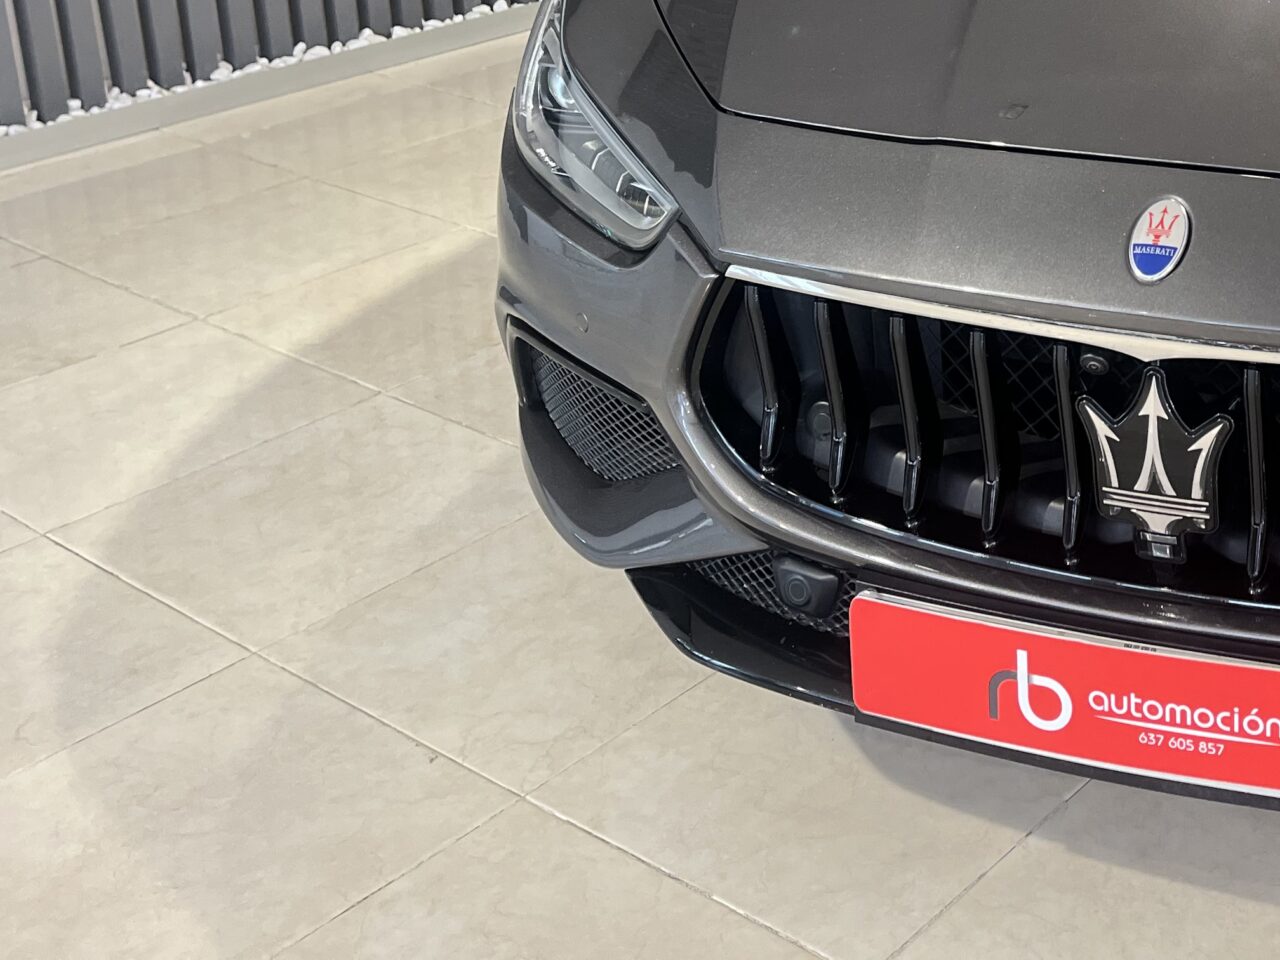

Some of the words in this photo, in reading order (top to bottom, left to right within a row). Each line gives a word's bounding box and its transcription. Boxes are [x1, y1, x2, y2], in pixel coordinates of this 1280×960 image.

[1133, 246, 1175, 257] MASERATI
[988, 649, 1073, 732] rb
[1138, 732, 1164, 747] 637
[1168, 736, 1195, 752] 605
[1198, 739, 1225, 756] 857
